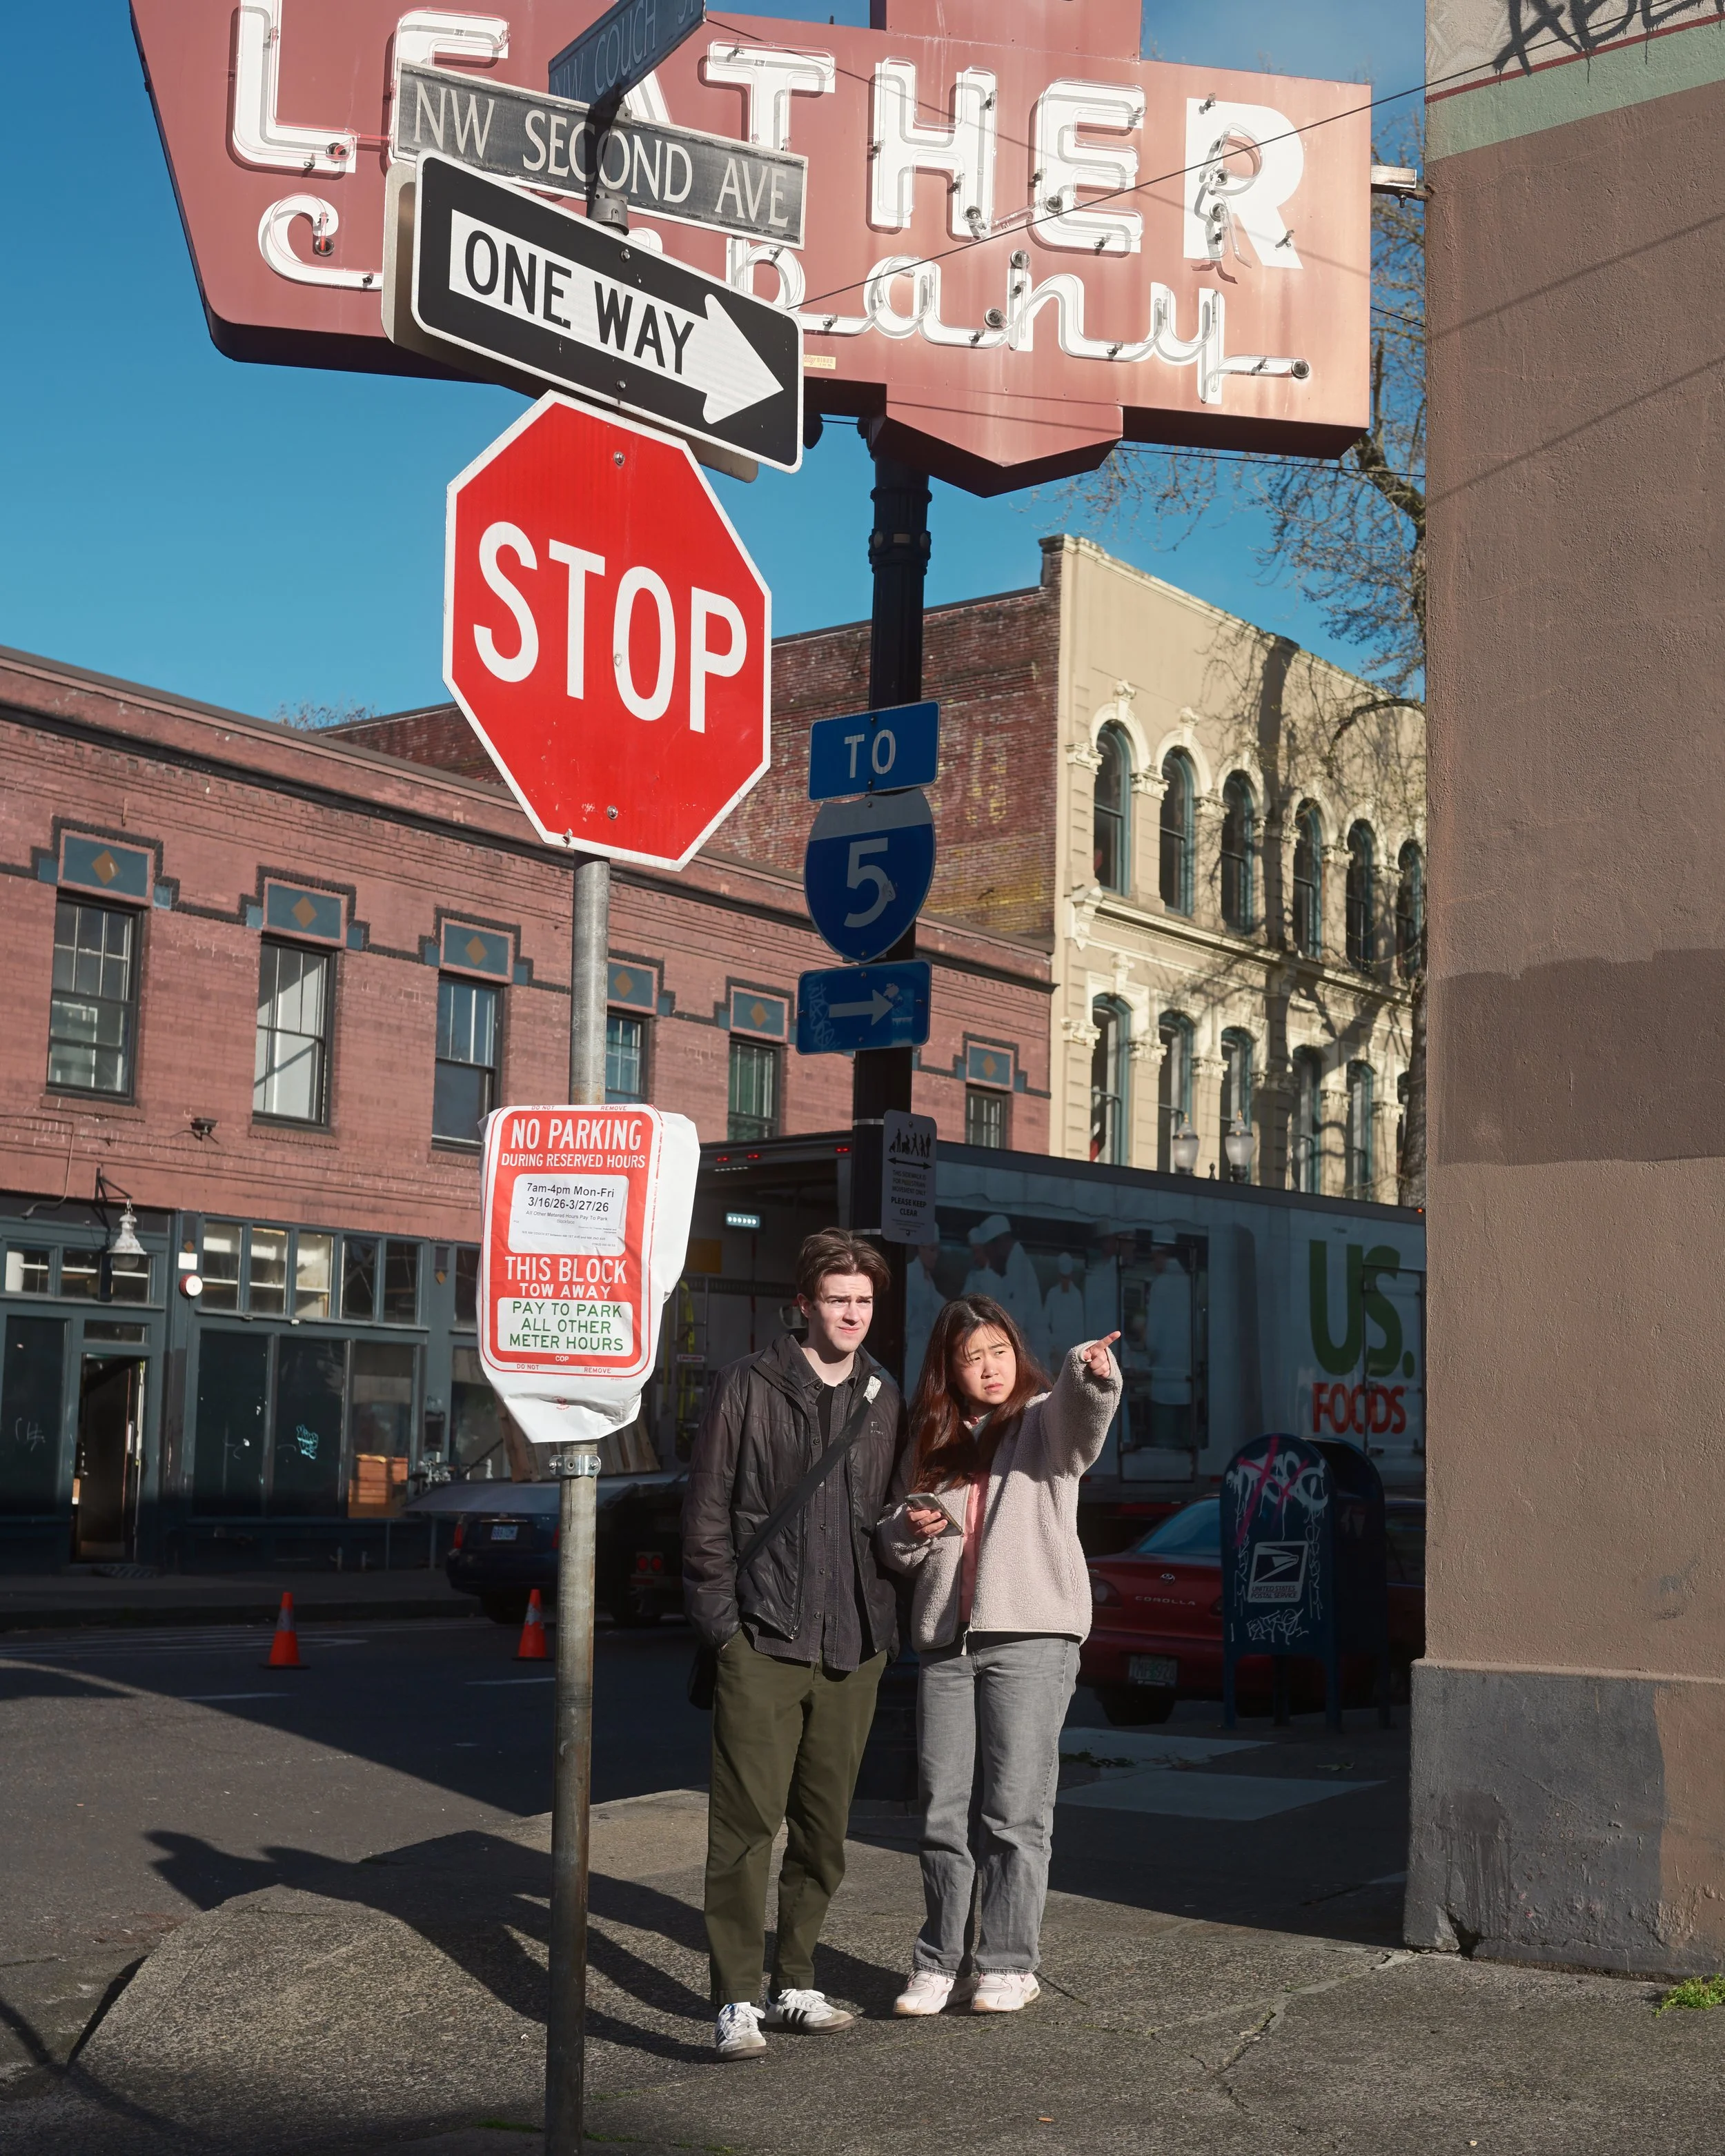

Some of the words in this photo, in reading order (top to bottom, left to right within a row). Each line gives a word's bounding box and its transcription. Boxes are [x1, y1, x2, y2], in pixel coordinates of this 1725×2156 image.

[595, 0, 656, 96] COUCH
[233, 0, 1303, 269] LTHER
[413, 81, 495, 159] NW
[522, 110, 693, 204] SECOND
[715, 158, 789, 228] AVE
[258, 192, 1309, 404] Cpany
[464, 230, 572, 330] ONE
[594, 280, 695, 375] WAY
[473, 521, 747, 733] STOP
[844, 729, 896, 778] TO
[843, 837, 889, 928] 5
[511, 1118, 540, 1149] NO
[548, 1118, 642, 1151] PARKING
[501, 1153, 543, 1167] DURING
[546, 1154, 603, 1168] RESERVED
[607, 1154, 646, 1168] HOURS
[526, 1183, 571, 1195] 7am-4pm
[573, 1185, 615, 1198] Mon-Fri
[902, 1178, 926, 1188] PESTRIAN
[528, 1196, 609, 1212] 3/16/26-3/27/26
[891, 1196, 912, 1206] PLEASE
[912, 1199, 927, 1208] KEEP
[900, 1208, 918, 1217] CLEAR
[504, 1256, 551, 1281] THIS
[558, 1258, 627, 1284] BLOCK
[519, 1283, 554, 1297] TOW
[560, 1284, 611, 1299] AWAY
[513, 1300, 545, 1314] PAY
[551, 1303, 569, 1316] TO
[577, 1303, 622, 1318] PARK
[521, 1318, 551, 1332] ALL
[558, 1319, 611, 1334] OTHER
[510, 1333, 560, 1349] METER
[566, 1336, 623, 1352] HOURS
[1313, 1383, 1407, 1434] FOODS
[1135, 1596, 1196, 1606] COROLLA
